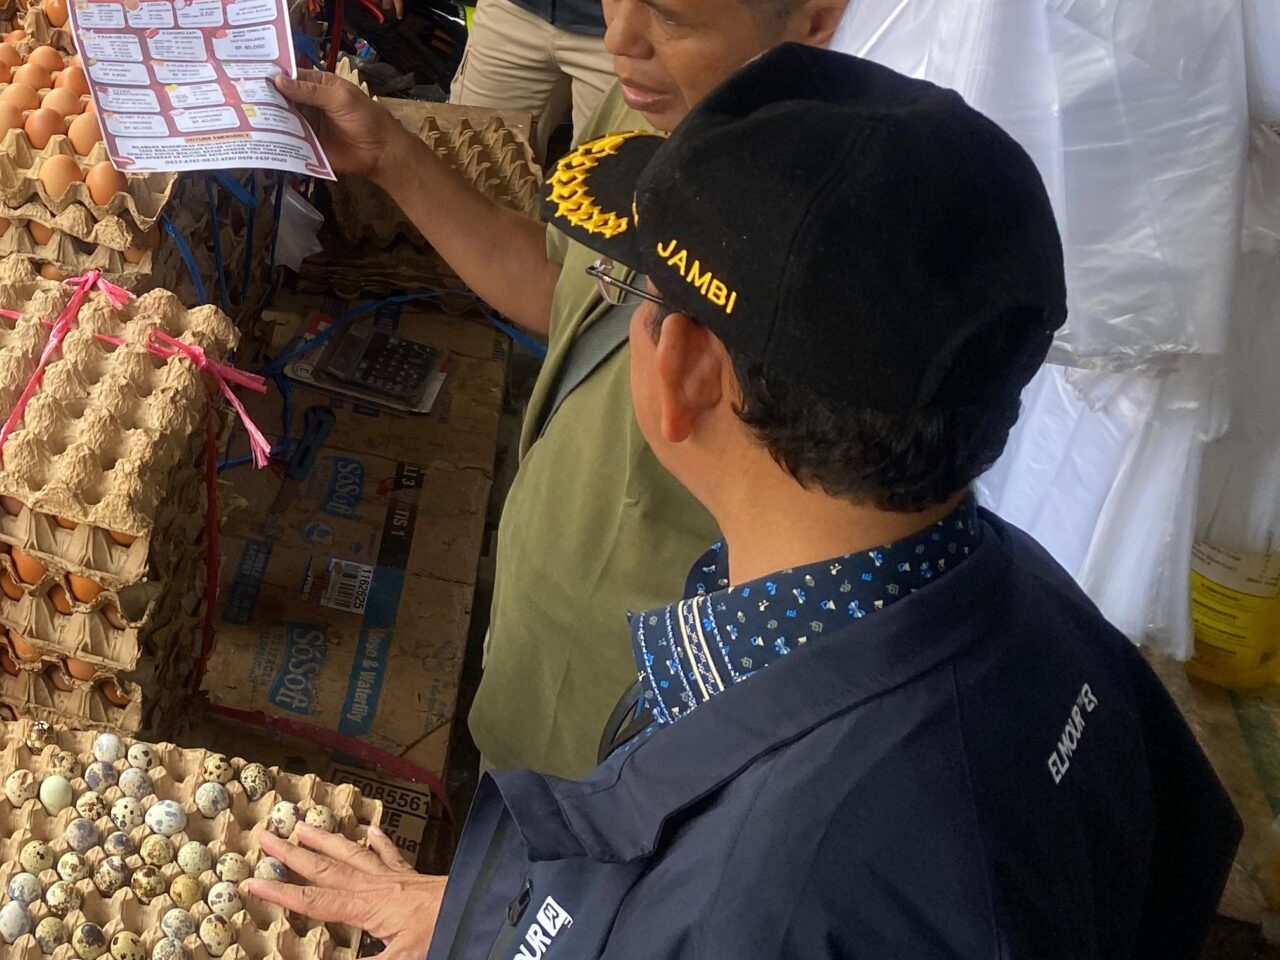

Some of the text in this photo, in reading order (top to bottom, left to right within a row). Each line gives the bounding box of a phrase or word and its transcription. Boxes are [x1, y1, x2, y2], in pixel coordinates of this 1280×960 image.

[657, 239, 737, 314] JAMBI
[353, 569, 373, 610] 1162625
[361, 659, 379, 668] &
[346, 670, 378, 724] Waterlily
[1048, 704, 1086, 785] ELMOUR
